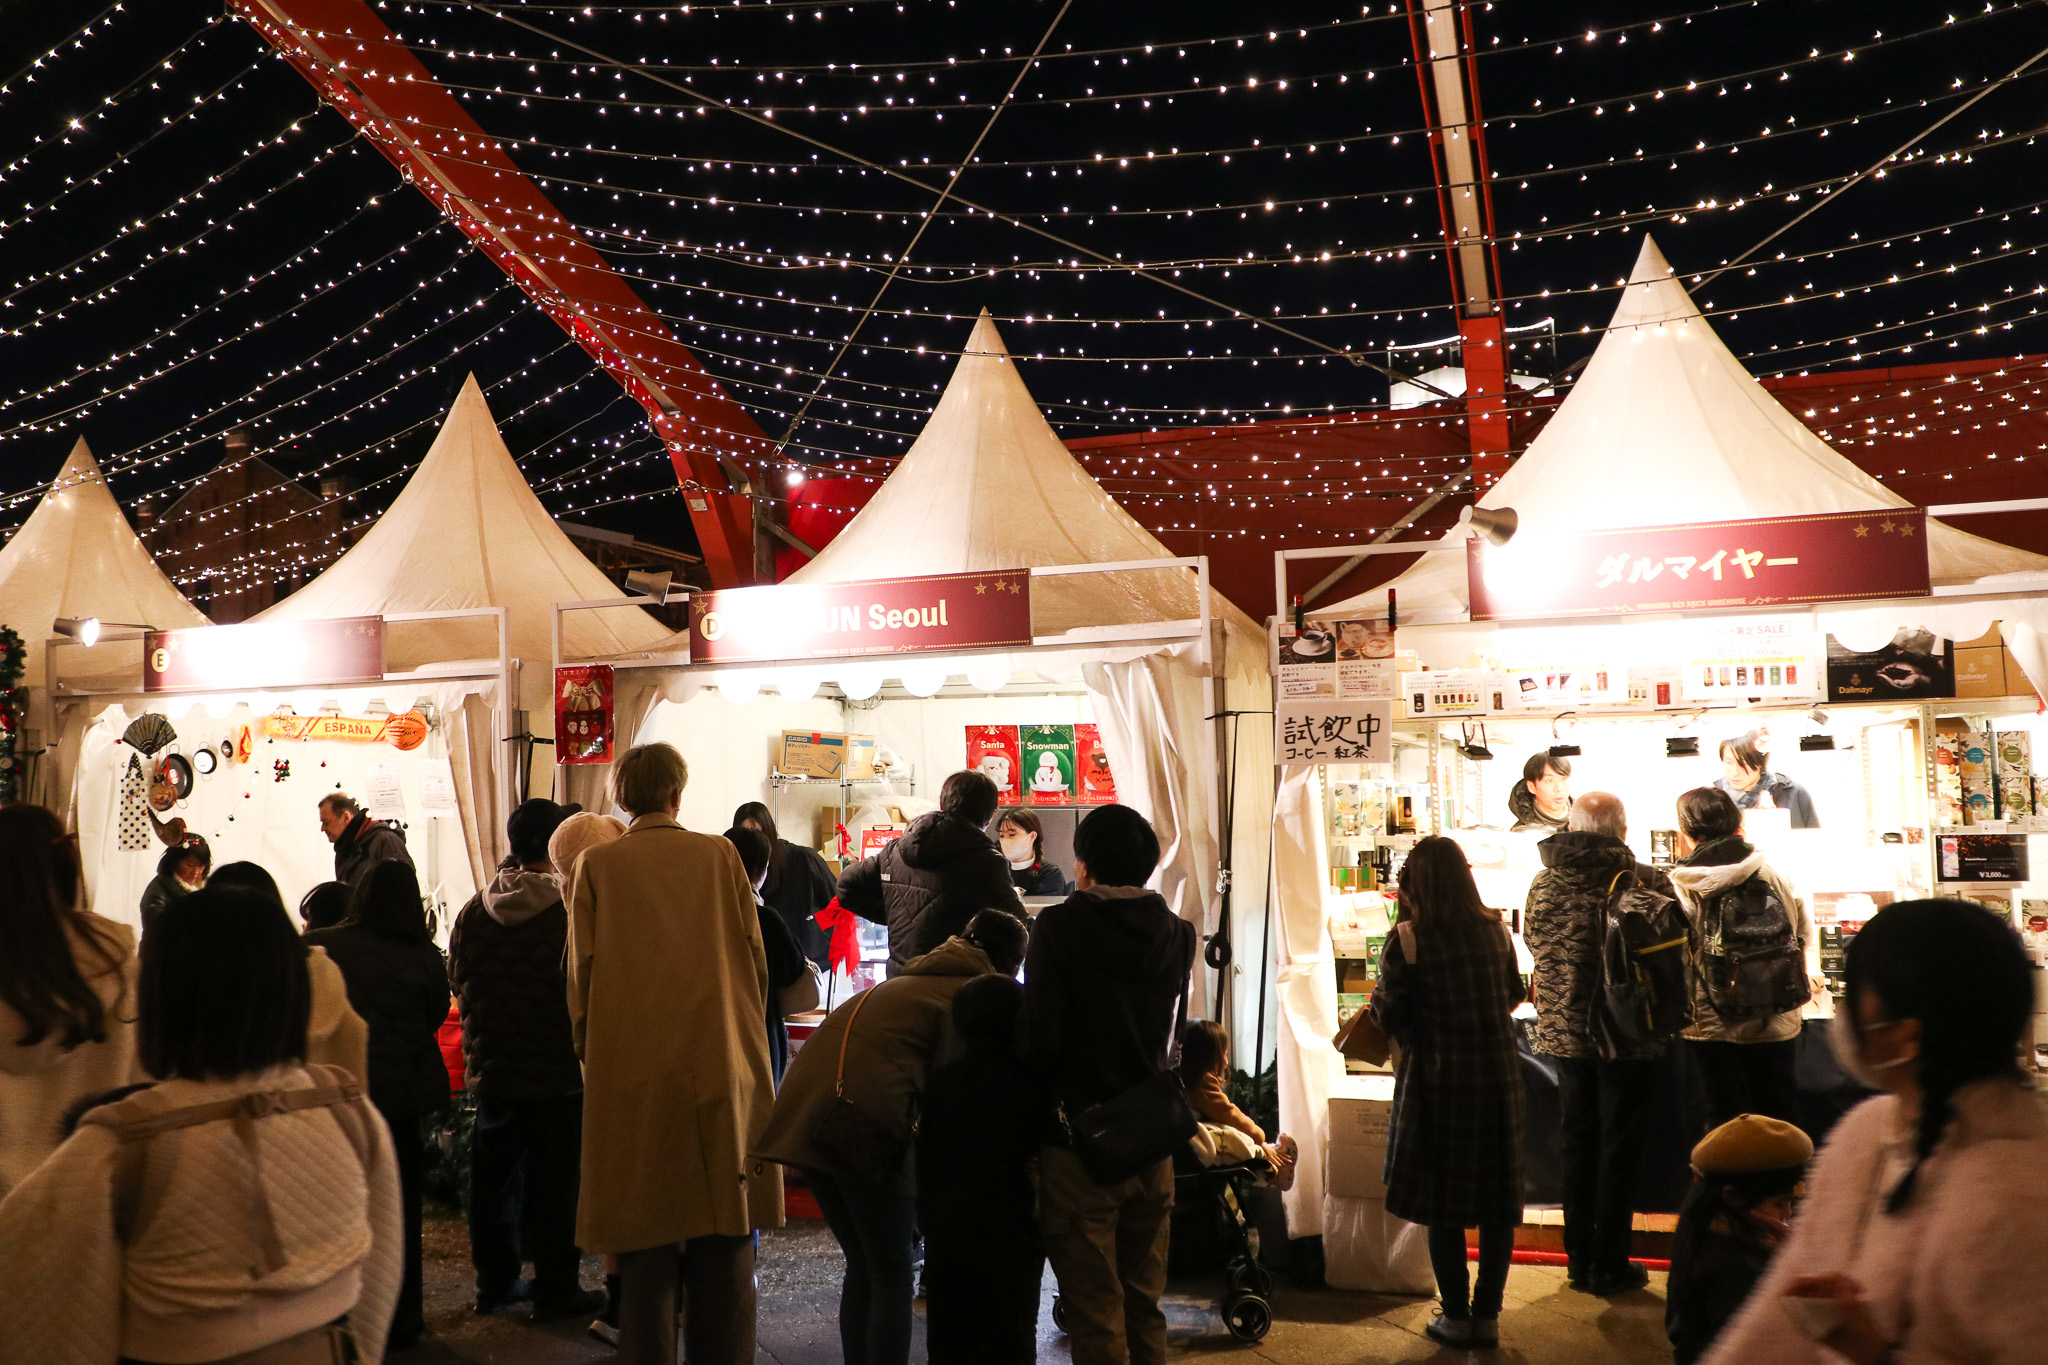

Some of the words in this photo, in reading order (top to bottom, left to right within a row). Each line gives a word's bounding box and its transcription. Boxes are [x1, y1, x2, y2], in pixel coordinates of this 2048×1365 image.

[1595, 548, 1799, 589] ダルマイヤー
[1686, 600, 1706, 608] BRICK
[1707, 597, 1747, 606] WAREHOUSE
[706, 617, 719, 636] D
[868, 599, 949, 630] Seoul
[1756, 624, 1785, 634] SALE
[157, 653, 165, 668] E
[1957, 673, 1988, 681] Dallmayr
[1838, 686, 1875, 695] Dallmayr
[324, 722, 372, 735] ESPAÑA
[1284, 713, 1381, 748] 試飲中
[787, 735, 808, 743] CASIO
[980, 740, 1005, 749] Santa
[1026, 741, 1070, 751] Snowman
